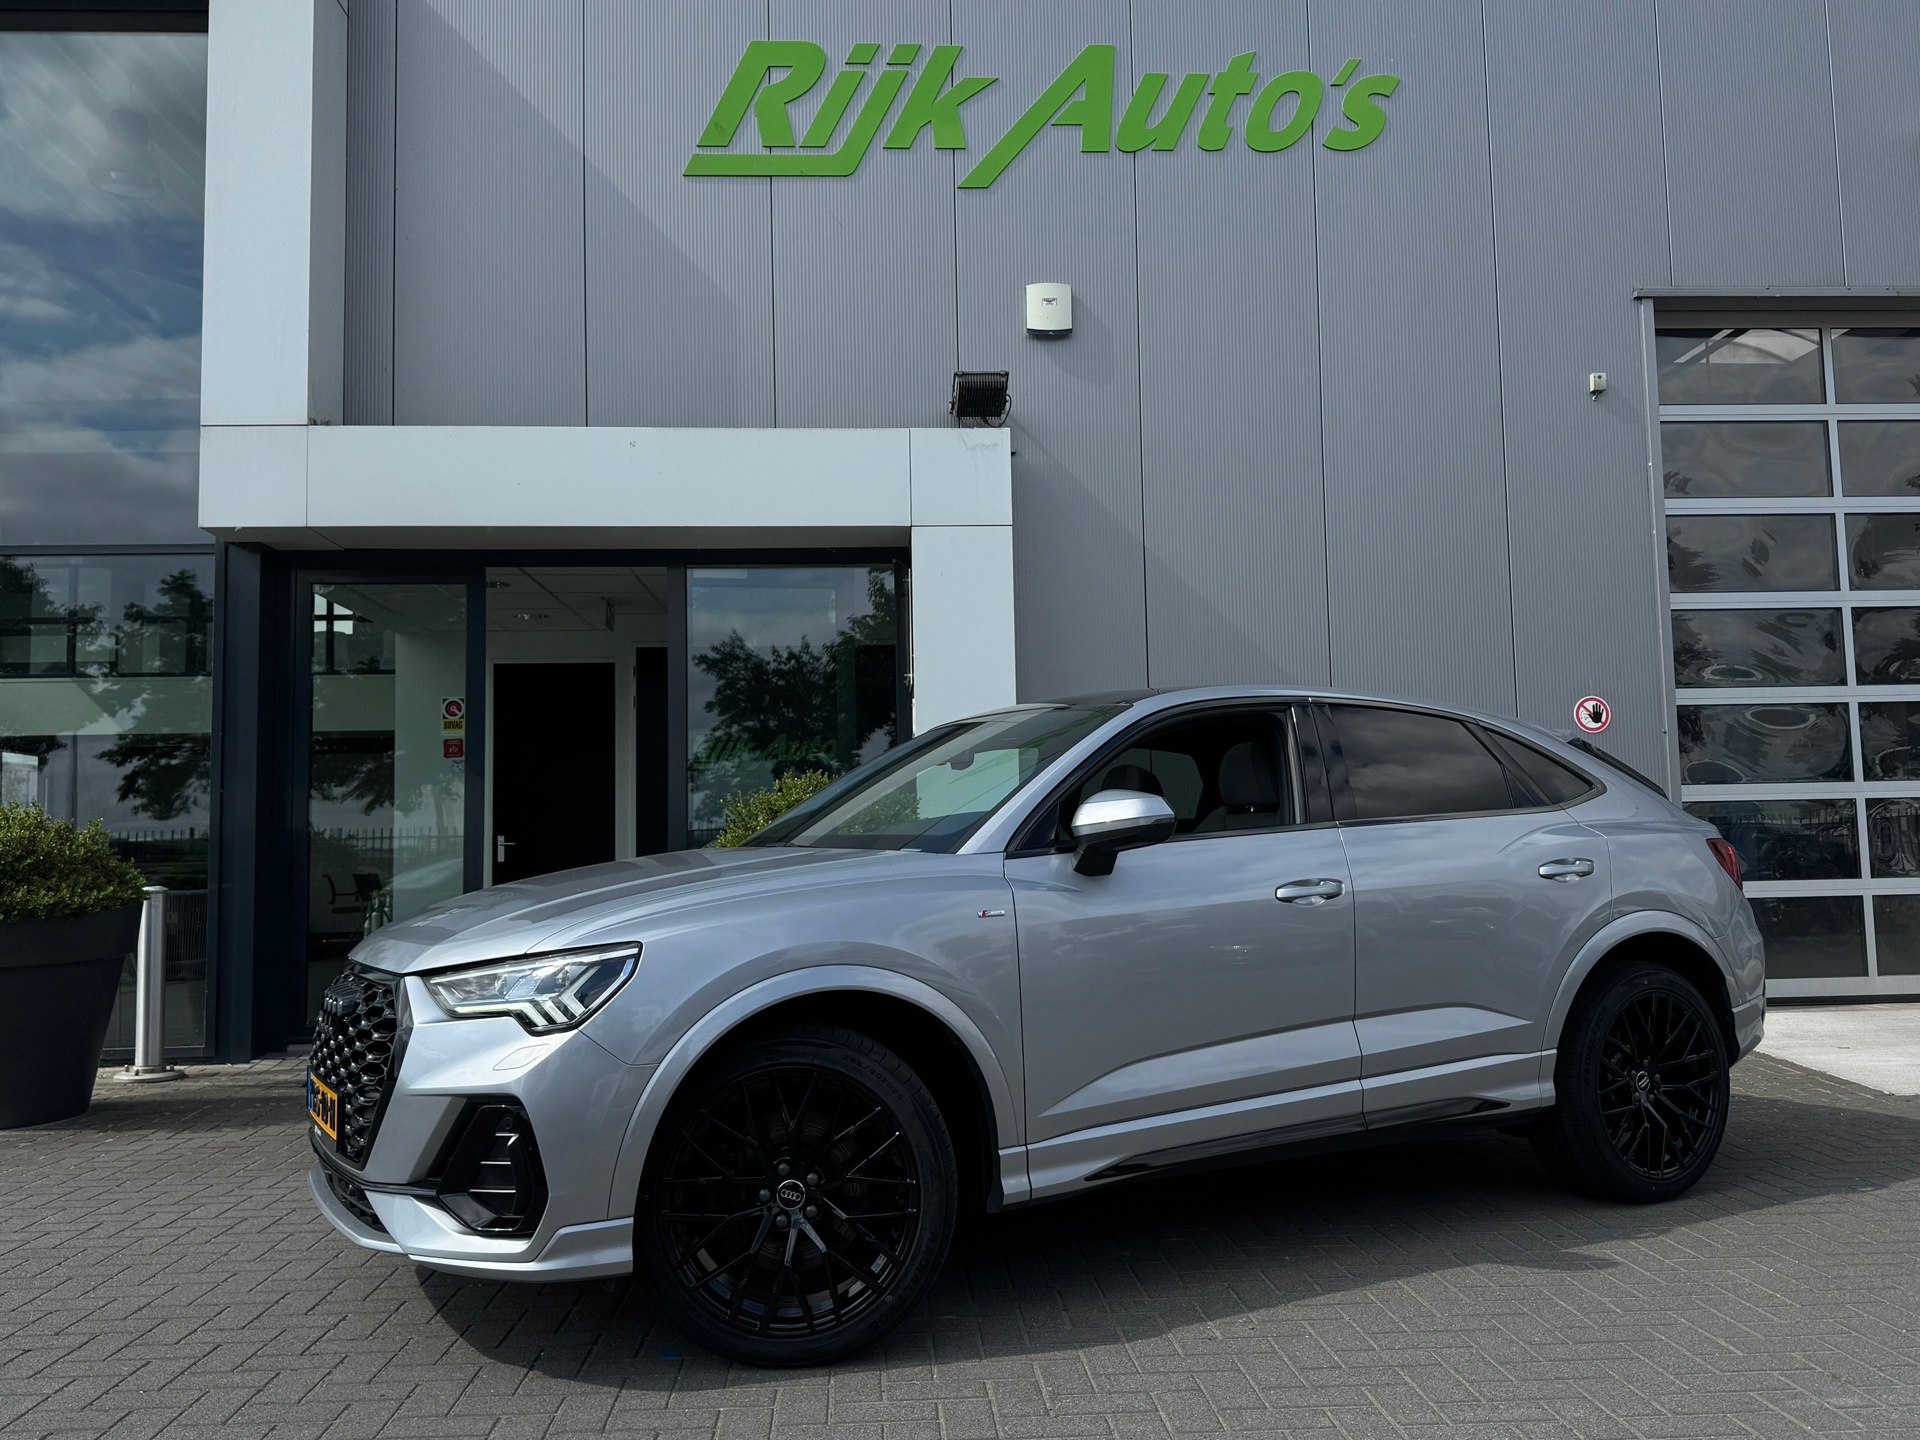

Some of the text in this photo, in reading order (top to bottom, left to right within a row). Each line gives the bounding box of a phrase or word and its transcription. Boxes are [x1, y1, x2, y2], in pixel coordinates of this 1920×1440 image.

[683, 40, 1401, 189] Rijk Auto's
[443, 720, 463, 730] BOVAG
